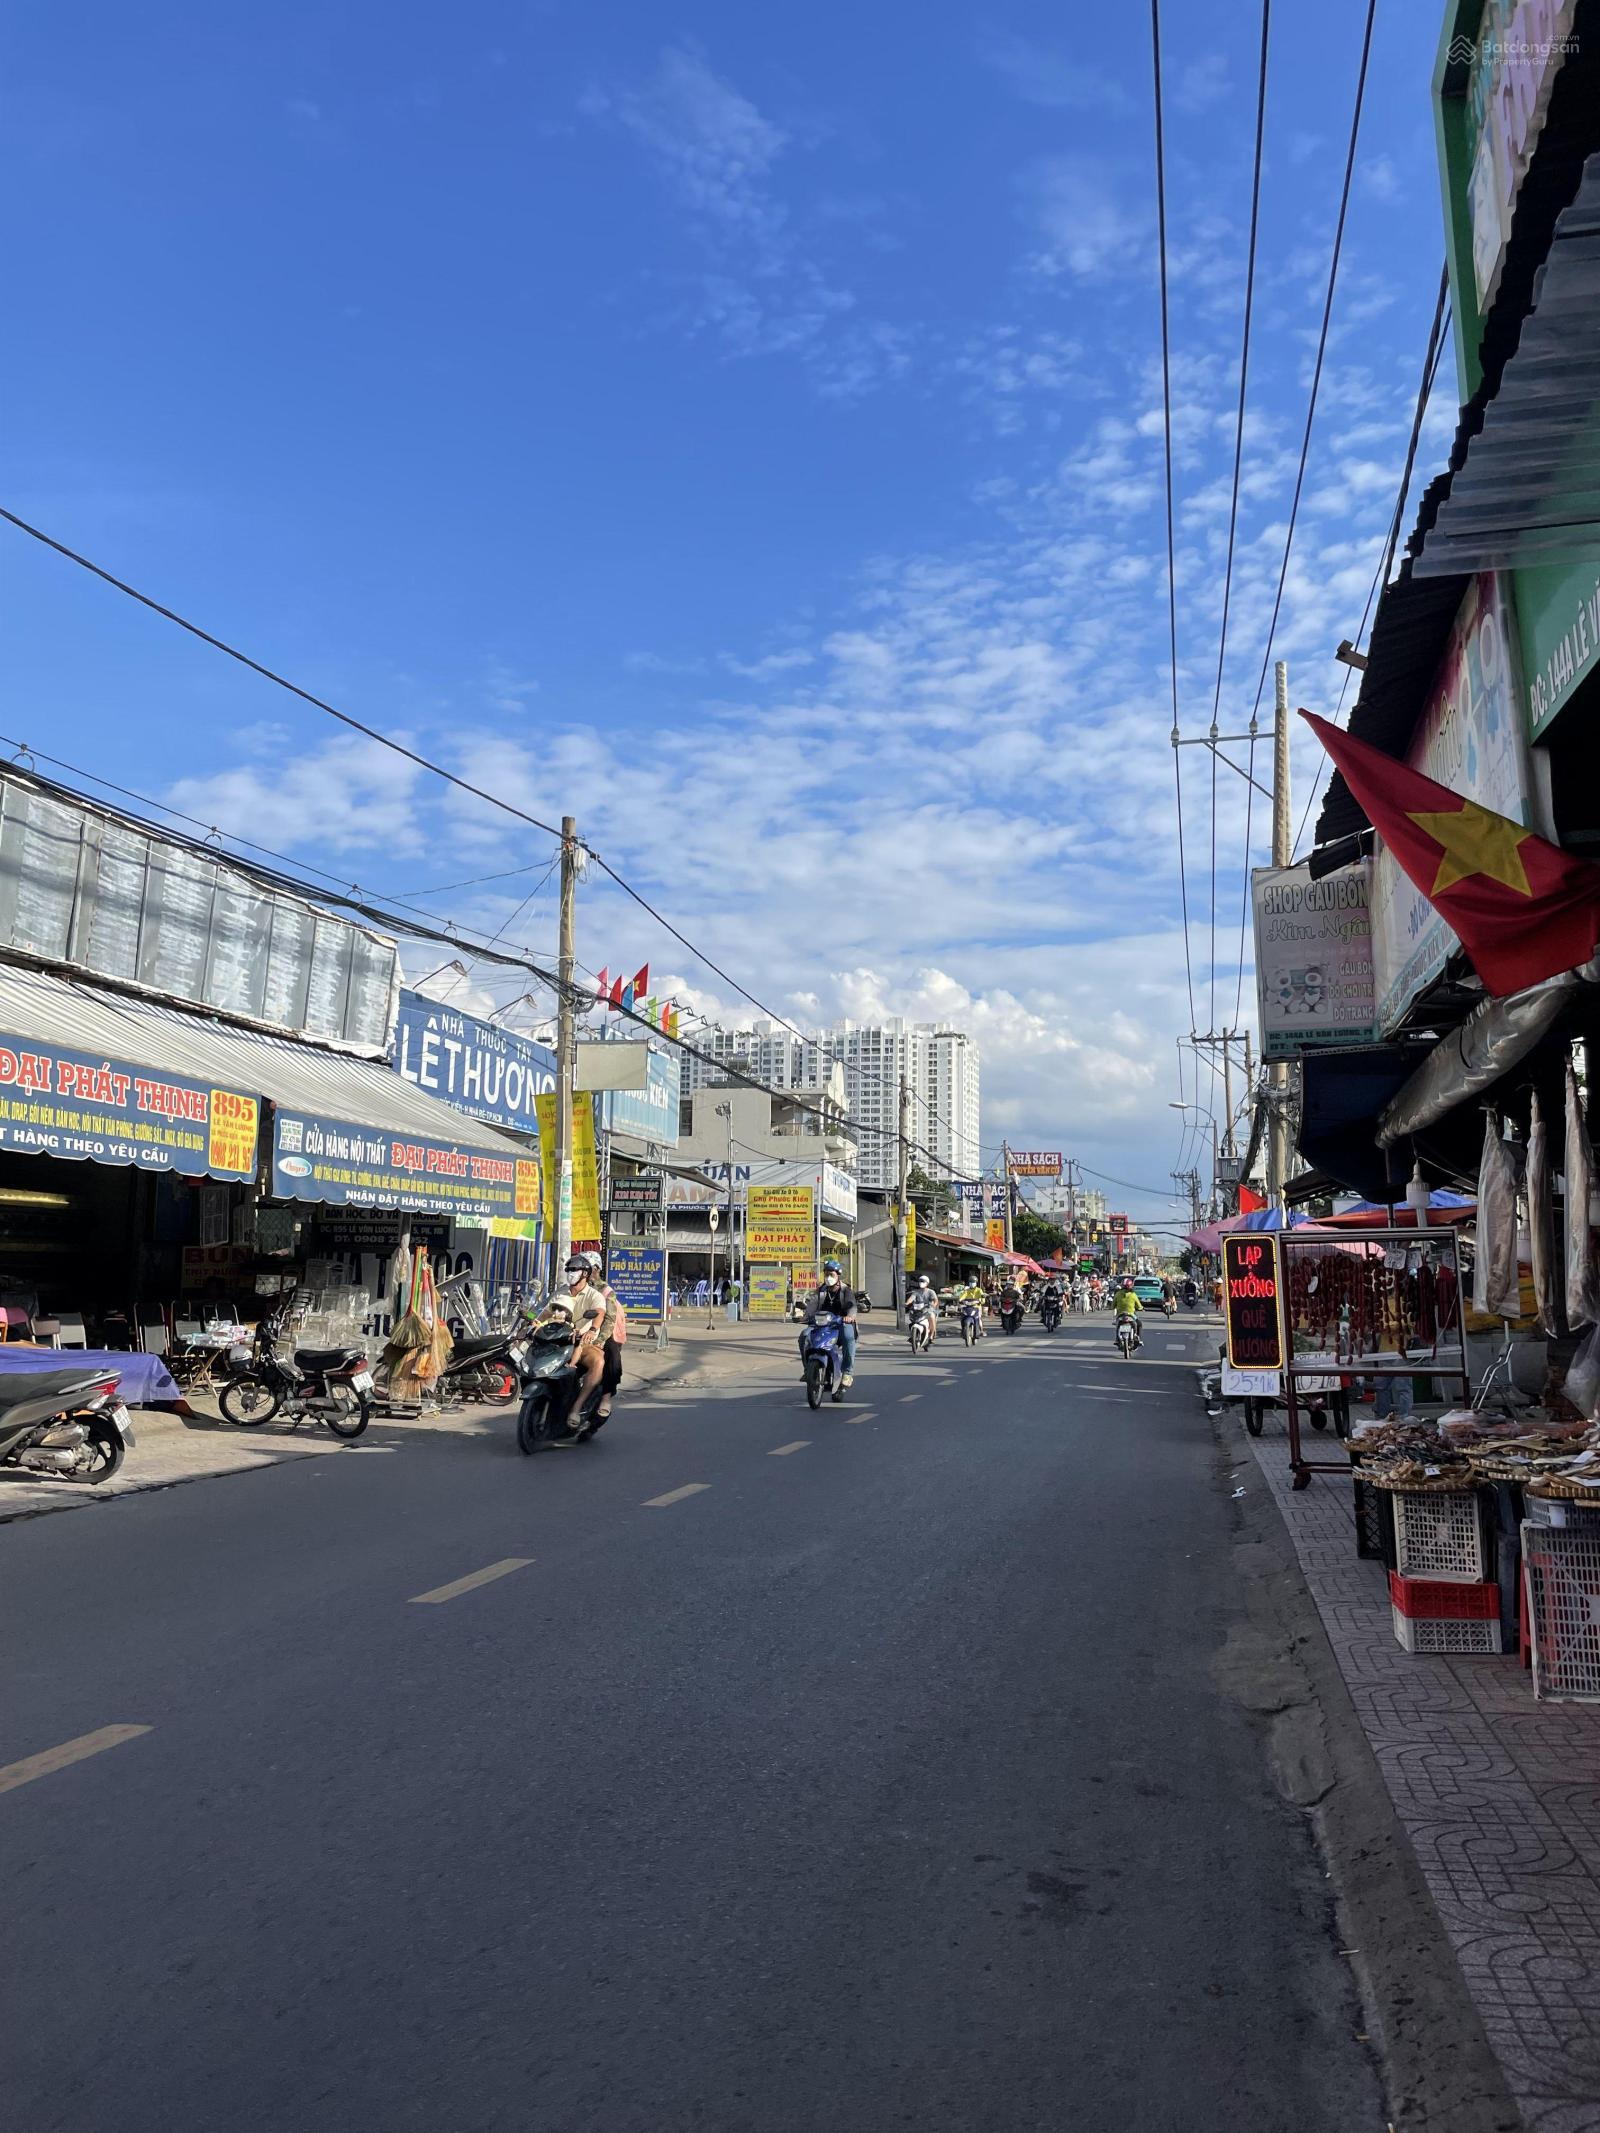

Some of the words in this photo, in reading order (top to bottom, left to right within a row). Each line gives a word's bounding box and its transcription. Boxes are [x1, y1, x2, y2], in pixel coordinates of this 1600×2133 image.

[1573, 598, 1591, 669] LÊ
[1264, 884, 1303, 915] SHOP
[1336, 874, 1370, 910] BÔN
[1265, 918, 1316, 943] Kim
[442, 1012, 464, 1038] NHÀ
[475, 1026, 507, 1055] THUỐC
[516, 1041, 533, 1063] TÂY
[0, 1047, 52, 1097] ĐẠI
[57, 1062, 130, 1107] PHÁT
[135, 1078, 209, 1123] THỊNH
[213, 1092, 254, 1122] 895
[13, 1128, 59, 1148] HÀNG
[62, 1136, 105, 1154] THEO
[108, 1142, 138, 1159] YÊU
[140, 1145, 169, 1164] CẦU
[305, 1122, 324, 1156] CỬA
[325, 1130, 349, 1160] HÀNG
[350, 1134, 365, 1166] NỘI
[365, 1136, 387, 1166] THẤT
[1010, 1152, 1032, 1165] NHÀ
[1032, 1151, 1059, 1166] SÁCH
[391, 1141, 425, 1175] ĐẠI
[426, 1147, 469, 1178] PHÁT
[470, 1156, 513, 1186] THỊNH
[516, 1160, 538, 1179] 895
[345, 1189, 376, 1203] NHẬN
[378, 1193, 400, 1206] ĐẶT
[401, 1195, 429, 1209] HÀNG
[429, 1199, 454, 1210] THEO
[455, 1200, 473, 1212] YÊU
[474, 1201, 491, 1213] CẦU
[962, 1183, 984, 1196] NHÀ
[754, 1234, 775, 1244] ĐẠI
[777, 1232, 806, 1243] PHÁT
[1237, 1245, 1264, 1271] LẠP
[1230, 1270, 1276, 1299] XƯỞNG
[1240, 1304, 1267, 1330] QUÊ
